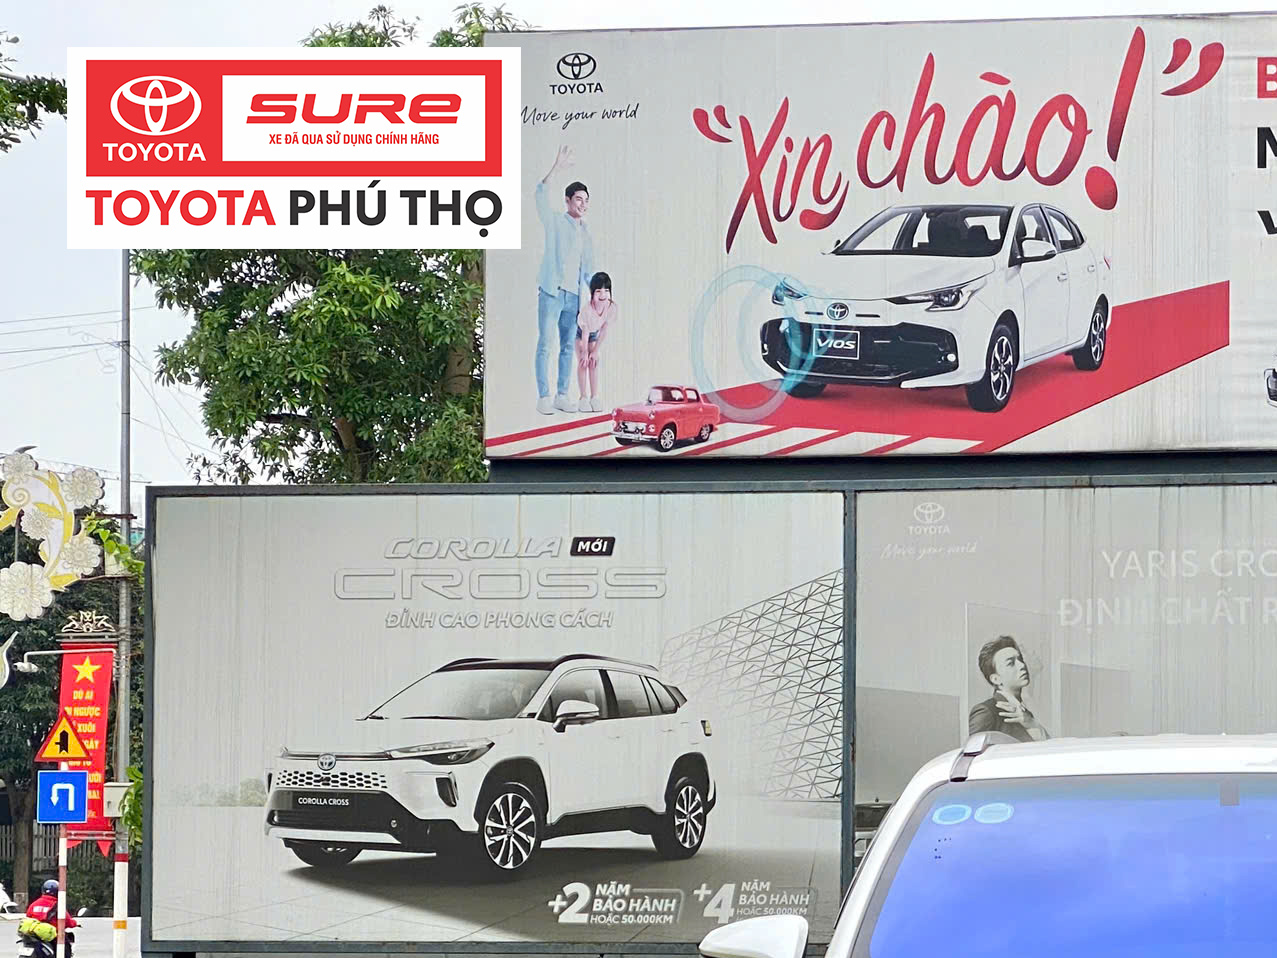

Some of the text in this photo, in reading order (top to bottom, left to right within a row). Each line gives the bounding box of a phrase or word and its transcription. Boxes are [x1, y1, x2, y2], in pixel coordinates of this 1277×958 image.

[550, 83, 604, 95] TOYOTA
[562, 111, 597, 130] your
[602, 103, 640, 120] world
[817, 338, 856, 350] VIOS
[908, 525, 951, 535] TOYOTA
[383, 536, 608, 561] COROLLA MỚI
[1102, 549, 1198, 578] YARIS
[333, 567, 667, 600] CROSS
[385, 607, 615, 629] ĐỈNH CAO PHONG CÁCH
[298, 797, 349, 806] COROLLA CROSS
[595, 881, 631, 896] NĂM
[741, 878, 771, 892] NĂM
[548, 882, 591, 924] +2
[592, 892, 676, 912] BẢO HÀNH
[693, 883, 736, 924] +4
[738, 890, 810, 905] BẢO HÀNH
[590, 914, 673, 926] HOẶC 50.000KM
